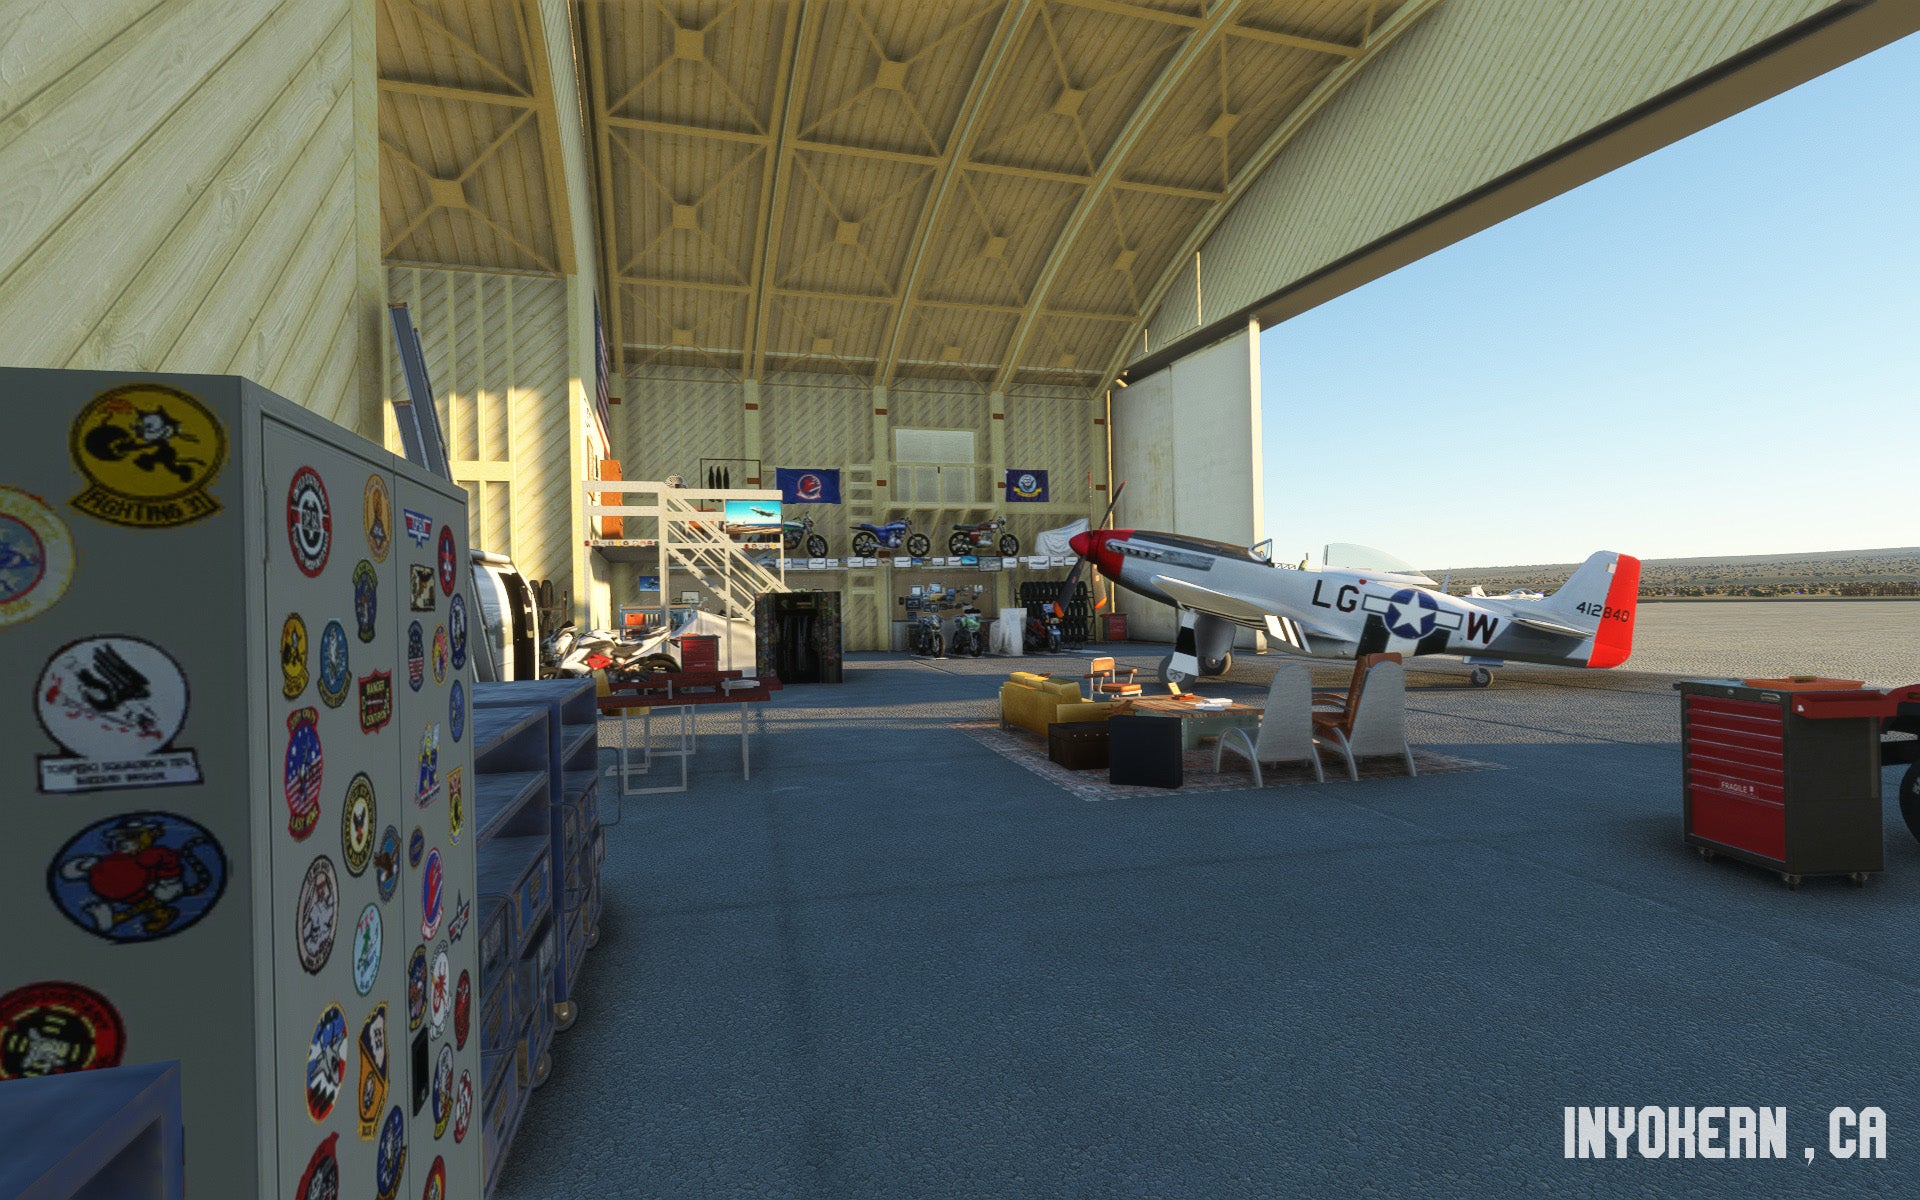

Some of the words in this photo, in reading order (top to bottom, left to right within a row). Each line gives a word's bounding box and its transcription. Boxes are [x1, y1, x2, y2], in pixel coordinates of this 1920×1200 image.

[82, 489, 184, 521] FIGHTING
[1312, 579, 1360, 613] LG
[1466, 611, 1499, 645] W
[1576, 601, 1630, 623] 412840
[1721, 780, 1748, 793] FRAGILE
